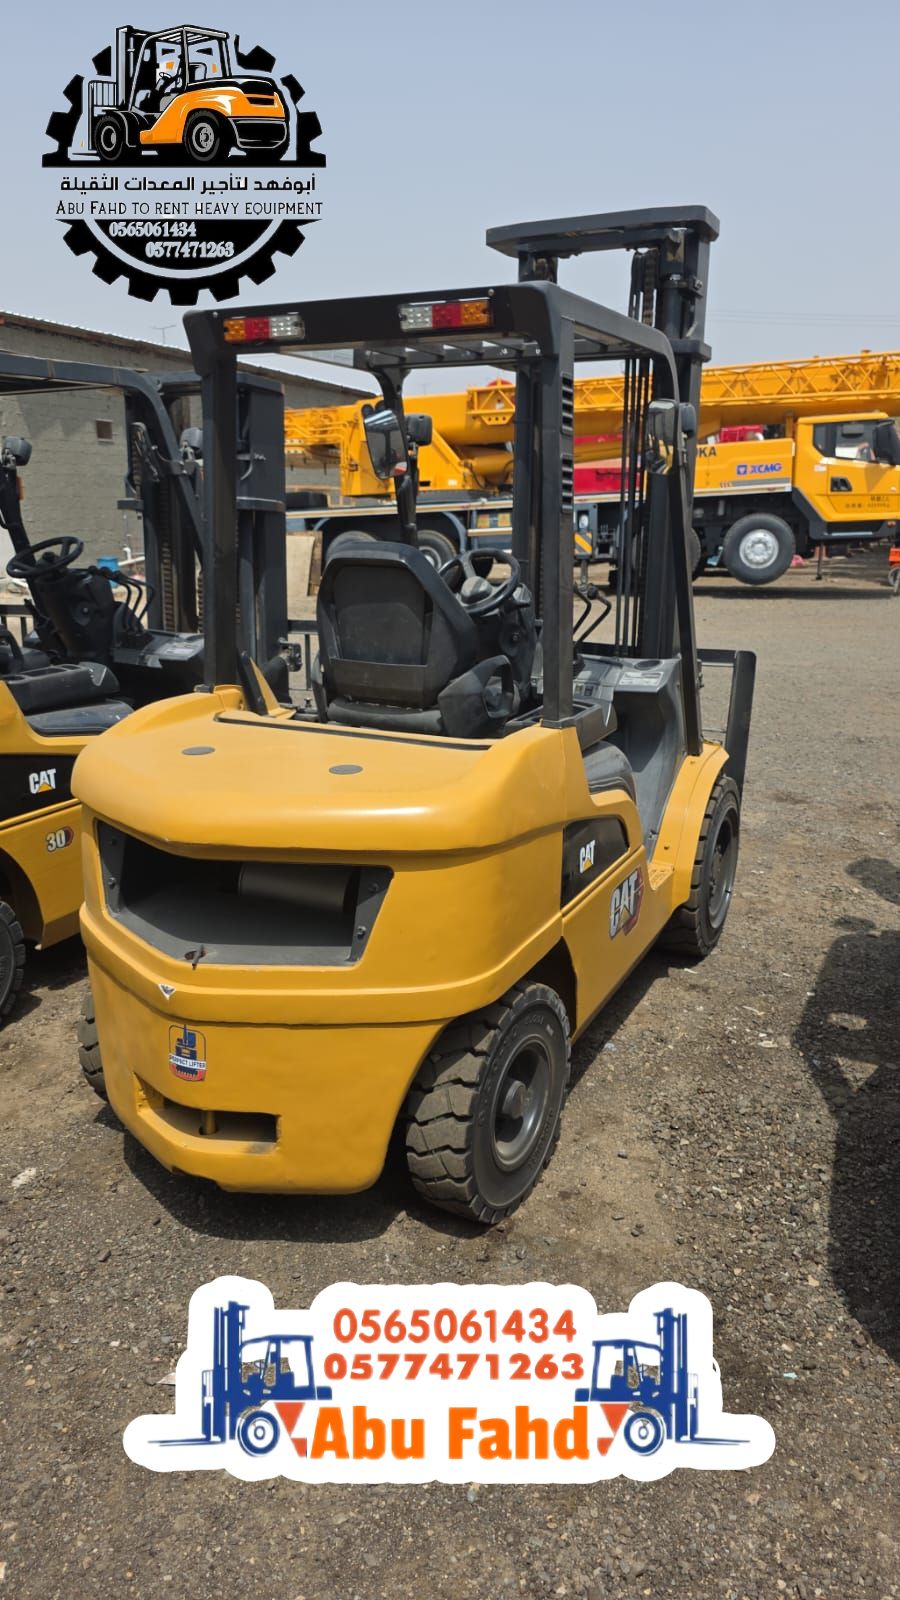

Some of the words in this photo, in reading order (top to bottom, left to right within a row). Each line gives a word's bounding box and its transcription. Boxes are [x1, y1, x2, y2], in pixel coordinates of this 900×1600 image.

[697, 446, 717, 458] KA
[749, 463, 782, 474] XCMG
[29, 769, 56, 793] CAT
[579, 839, 596, 873] CAT
[609, 870, 638, 939] CAT
[189, 1061, 206, 1069] LIFTER
